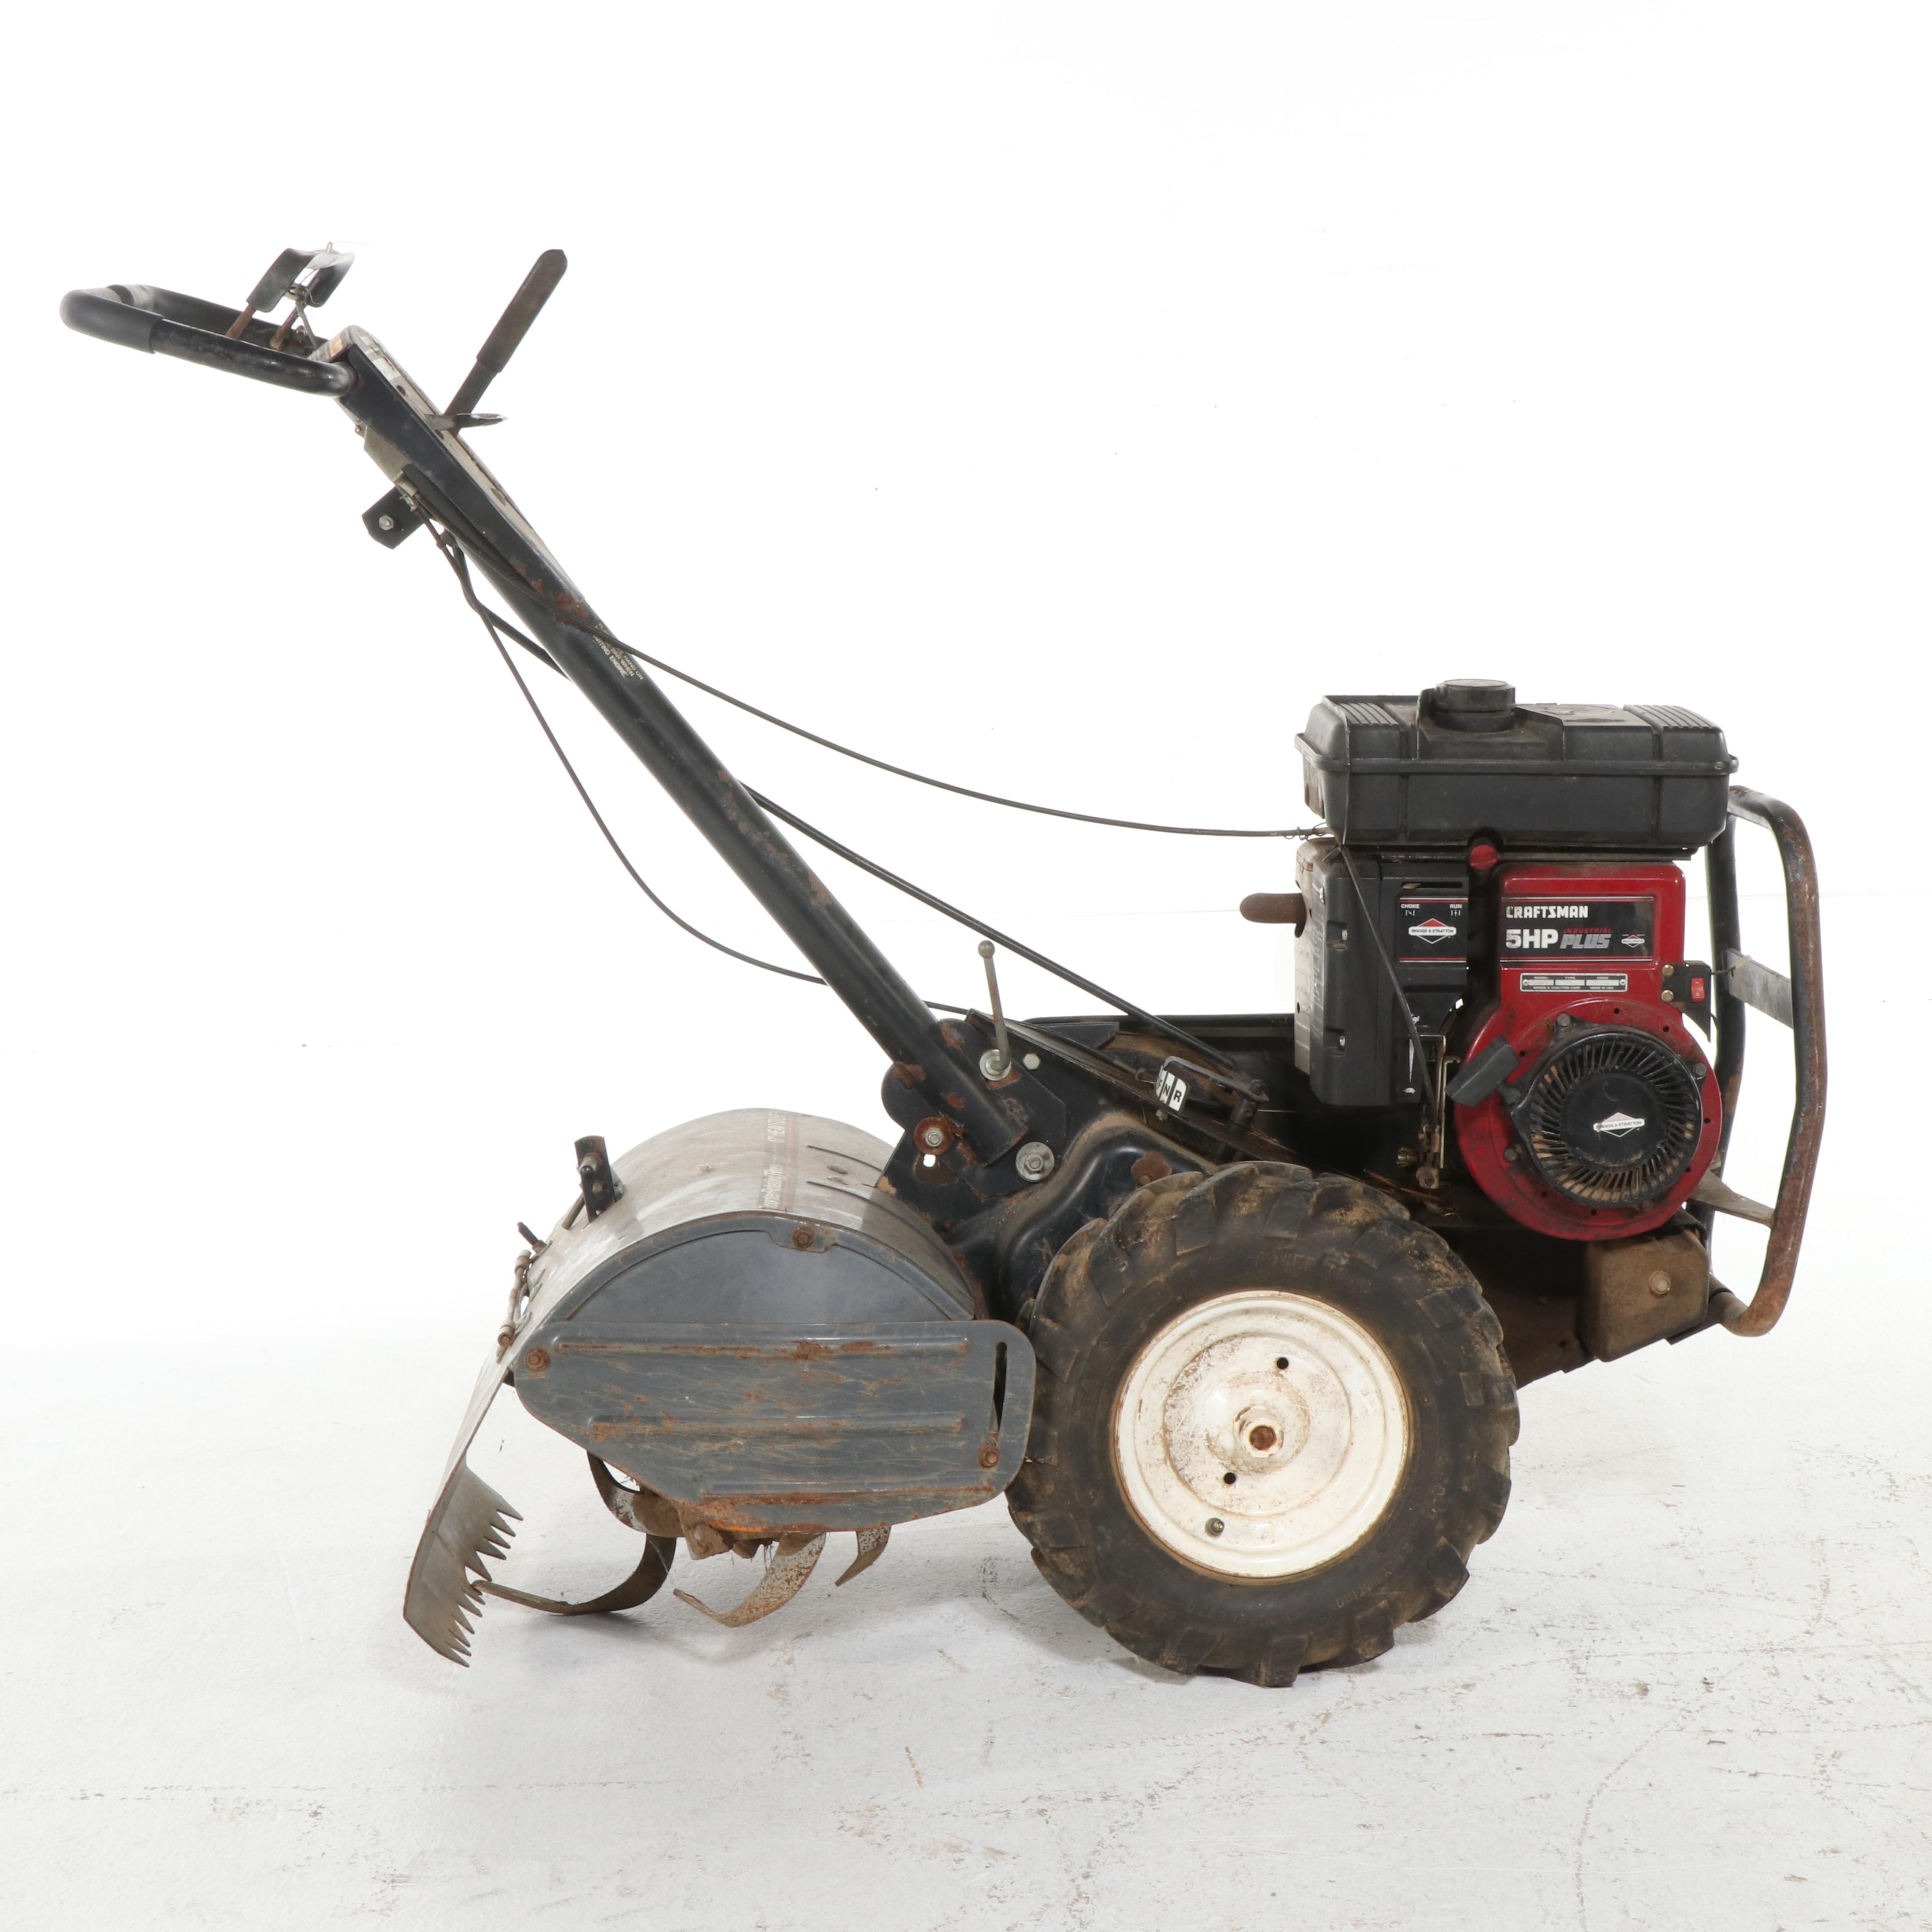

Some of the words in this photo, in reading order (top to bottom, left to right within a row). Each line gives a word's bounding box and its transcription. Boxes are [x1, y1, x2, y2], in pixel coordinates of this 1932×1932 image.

[620, 659, 635, 676] WHEN
[635, 670, 643, 680] ON
[1506, 906, 1589, 918] CRAFTSMAN
[1506, 929, 1559, 949] 5HP
[1560, 934, 1612, 949] PLUS
[1163, 1084, 1171, 1096] N
[1173, 1090, 1182, 1103] R
